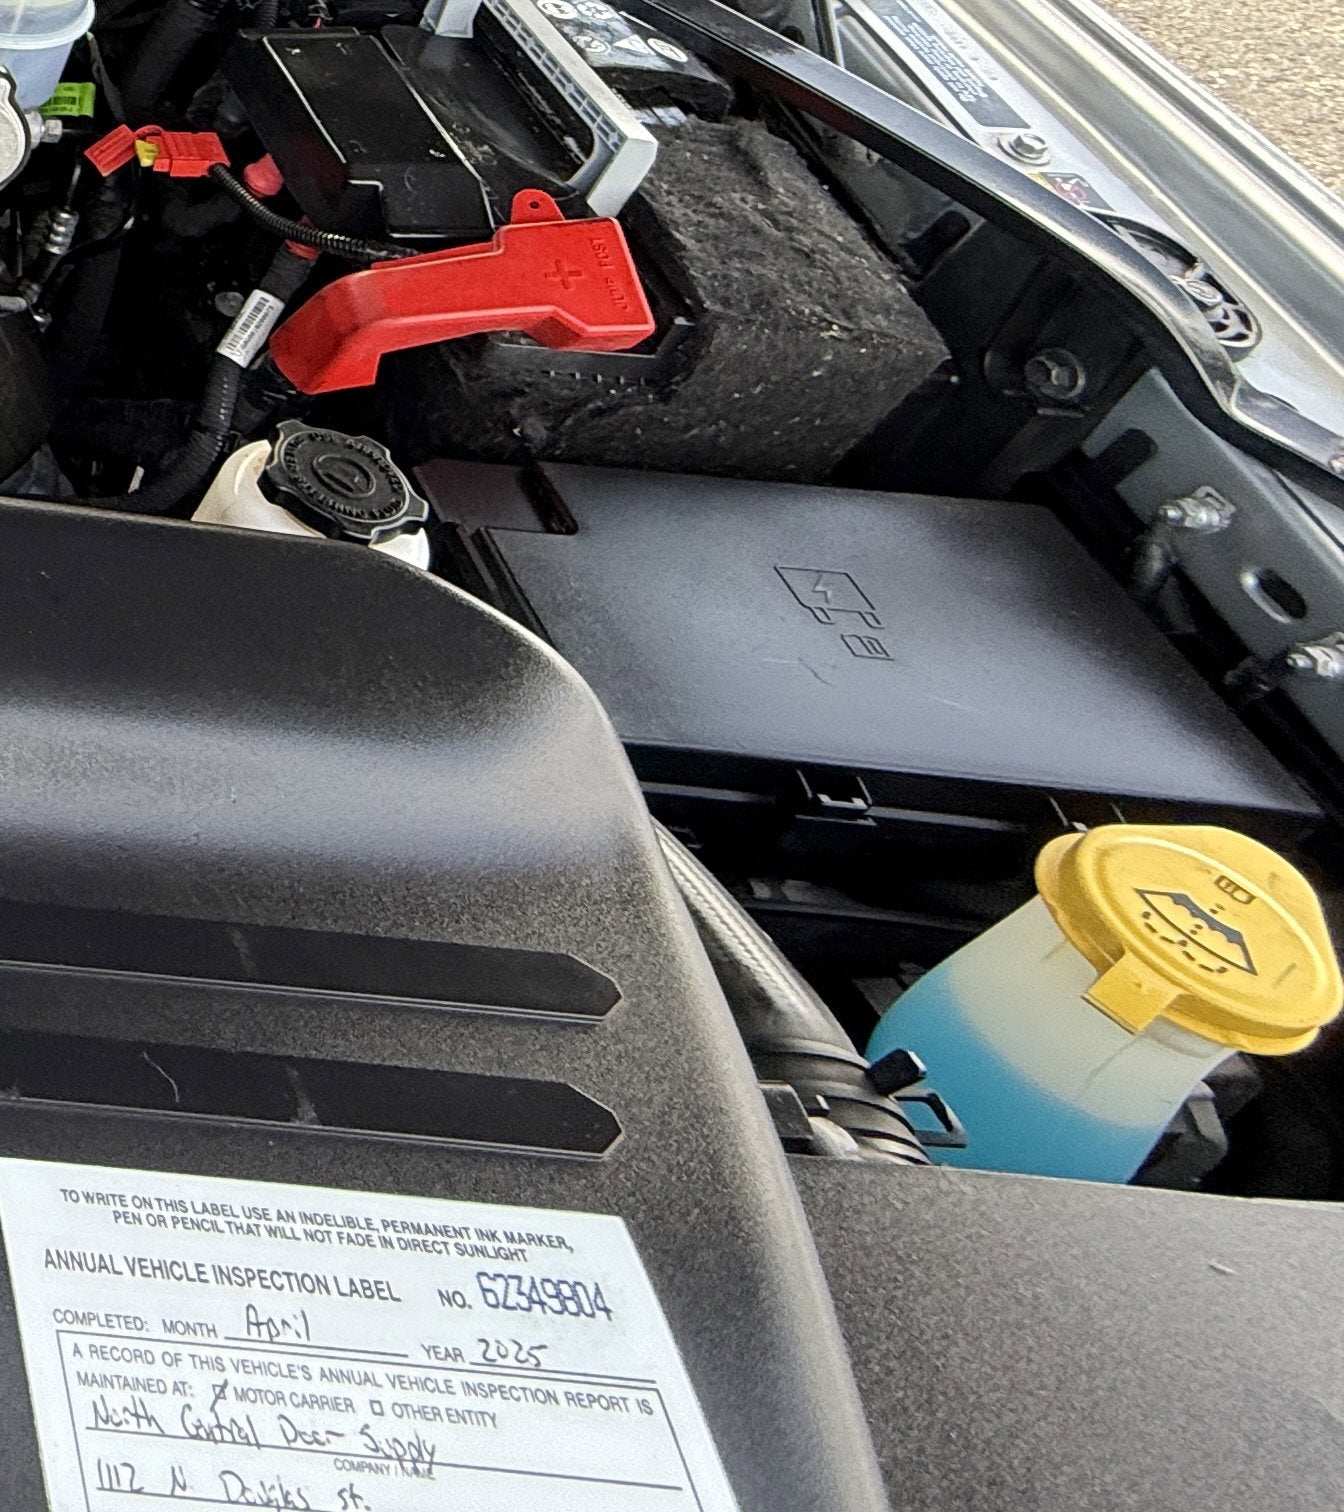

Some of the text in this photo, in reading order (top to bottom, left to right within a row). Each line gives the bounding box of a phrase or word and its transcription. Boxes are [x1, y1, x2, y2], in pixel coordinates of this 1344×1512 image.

[60, 1189, 575, 1254] TO WRITE ON THIS LABEL USE AN INDELIBLE, PERMANENT INK MARKER,
[112, 1210, 529, 1264] PEN OR PENCIL THAT WILL NOT FADE IN DIRECT SUNLIGHT
[43, 1248, 402, 1303] ANNUAL VEHICLE INSPECTION LABEL
[245, 1303, 312, 1343] April
[436, 1289, 473, 1310] NO.
[52, 1308, 218, 1339] COMPLETED: MONTH
[420, 1343, 466, 1363] YEAR
[477, 1338, 548, 1368] 2025
[72, 1343, 654, 1416] A RECORD OF THIS VEHICLE'S ANNUAL VEHICLE INSPECTION REPORT IS
[76, 1371, 498, 1429] MAINTAINED AT: MOTOR CARRIER OTHER ENTITY
[92, 1394, 166, 1435] North
[359, 1423, 437, 1476] Supply
[333, 1458, 391, 1477] COMPANY
